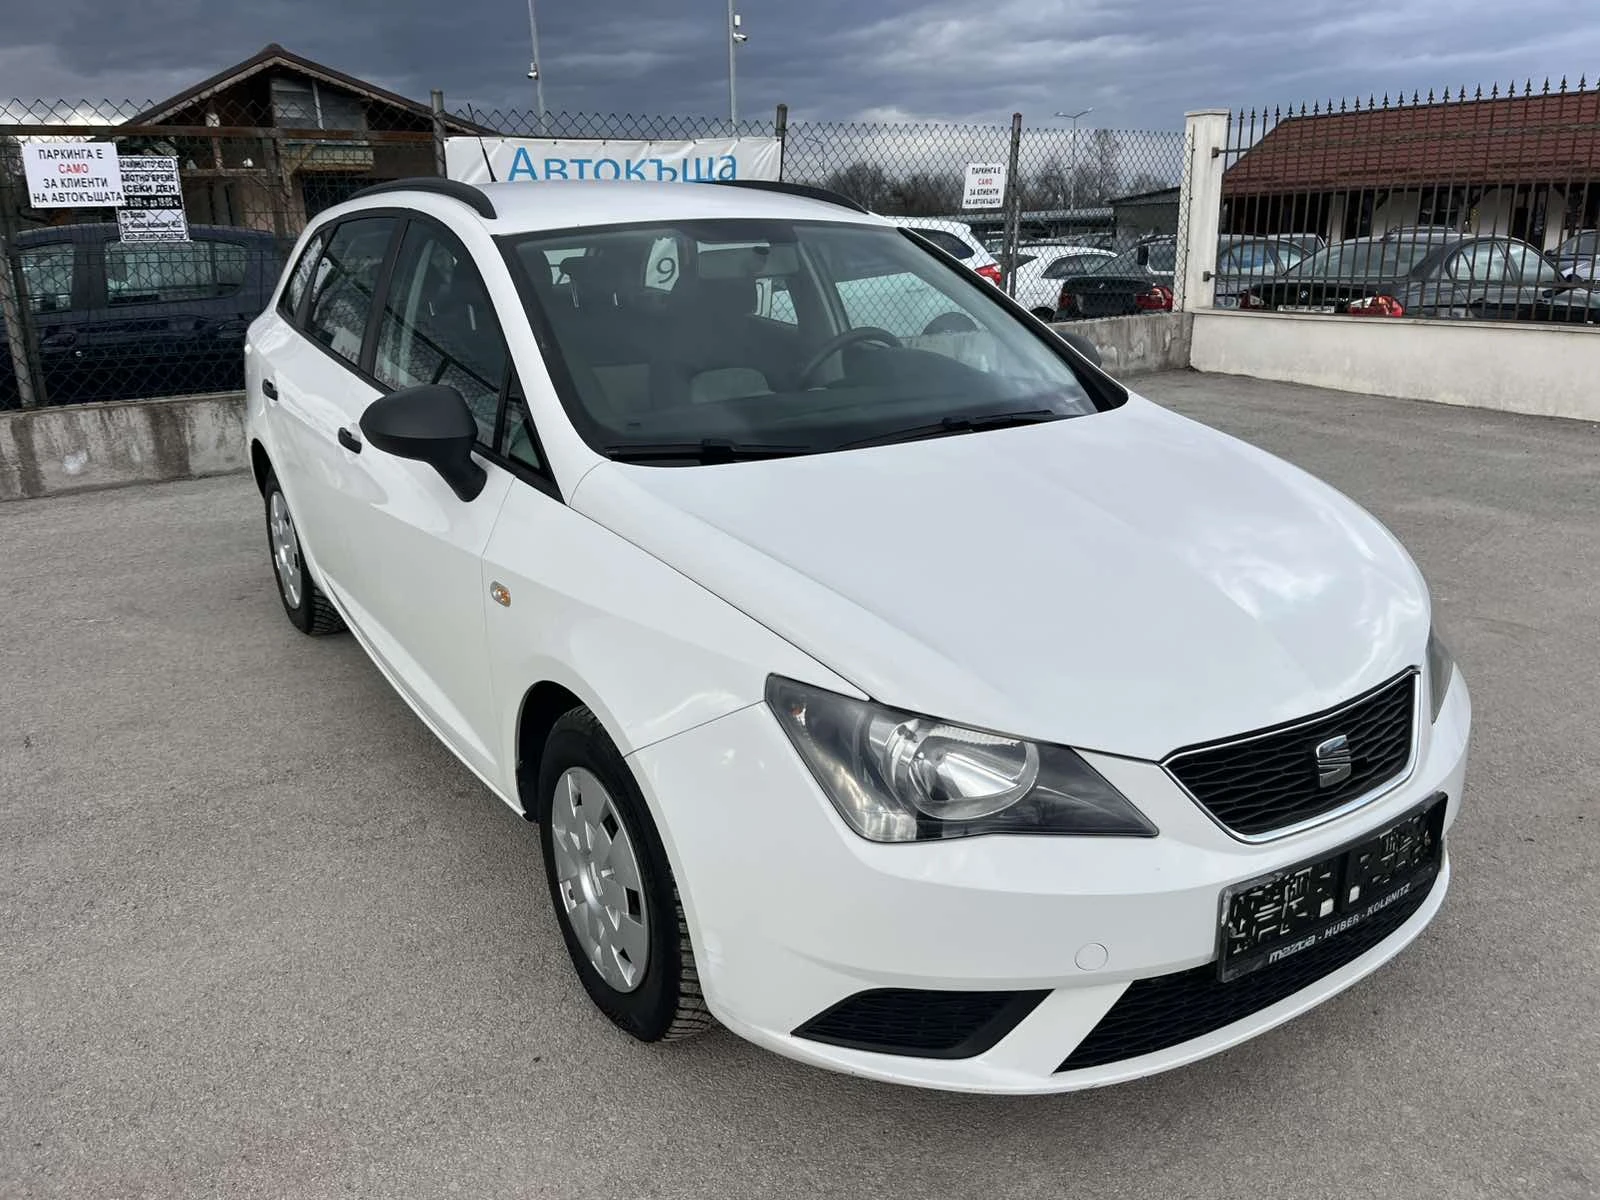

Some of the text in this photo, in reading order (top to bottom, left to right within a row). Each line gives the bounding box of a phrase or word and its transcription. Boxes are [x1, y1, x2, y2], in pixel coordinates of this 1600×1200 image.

[38, 149, 104, 160] ПАРКИНГА Е
[58, 163, 89, 174] САМО
[43, 178, 109, 189] ЗА КЛИЕНТИ
[155, 184, 176, 194] ДЕН
[33, 193, 49, 203] НА
[51, 191, 123, 203] АВТОКЪЩАТА
[1324, 914, 1360, 939] HUBER
